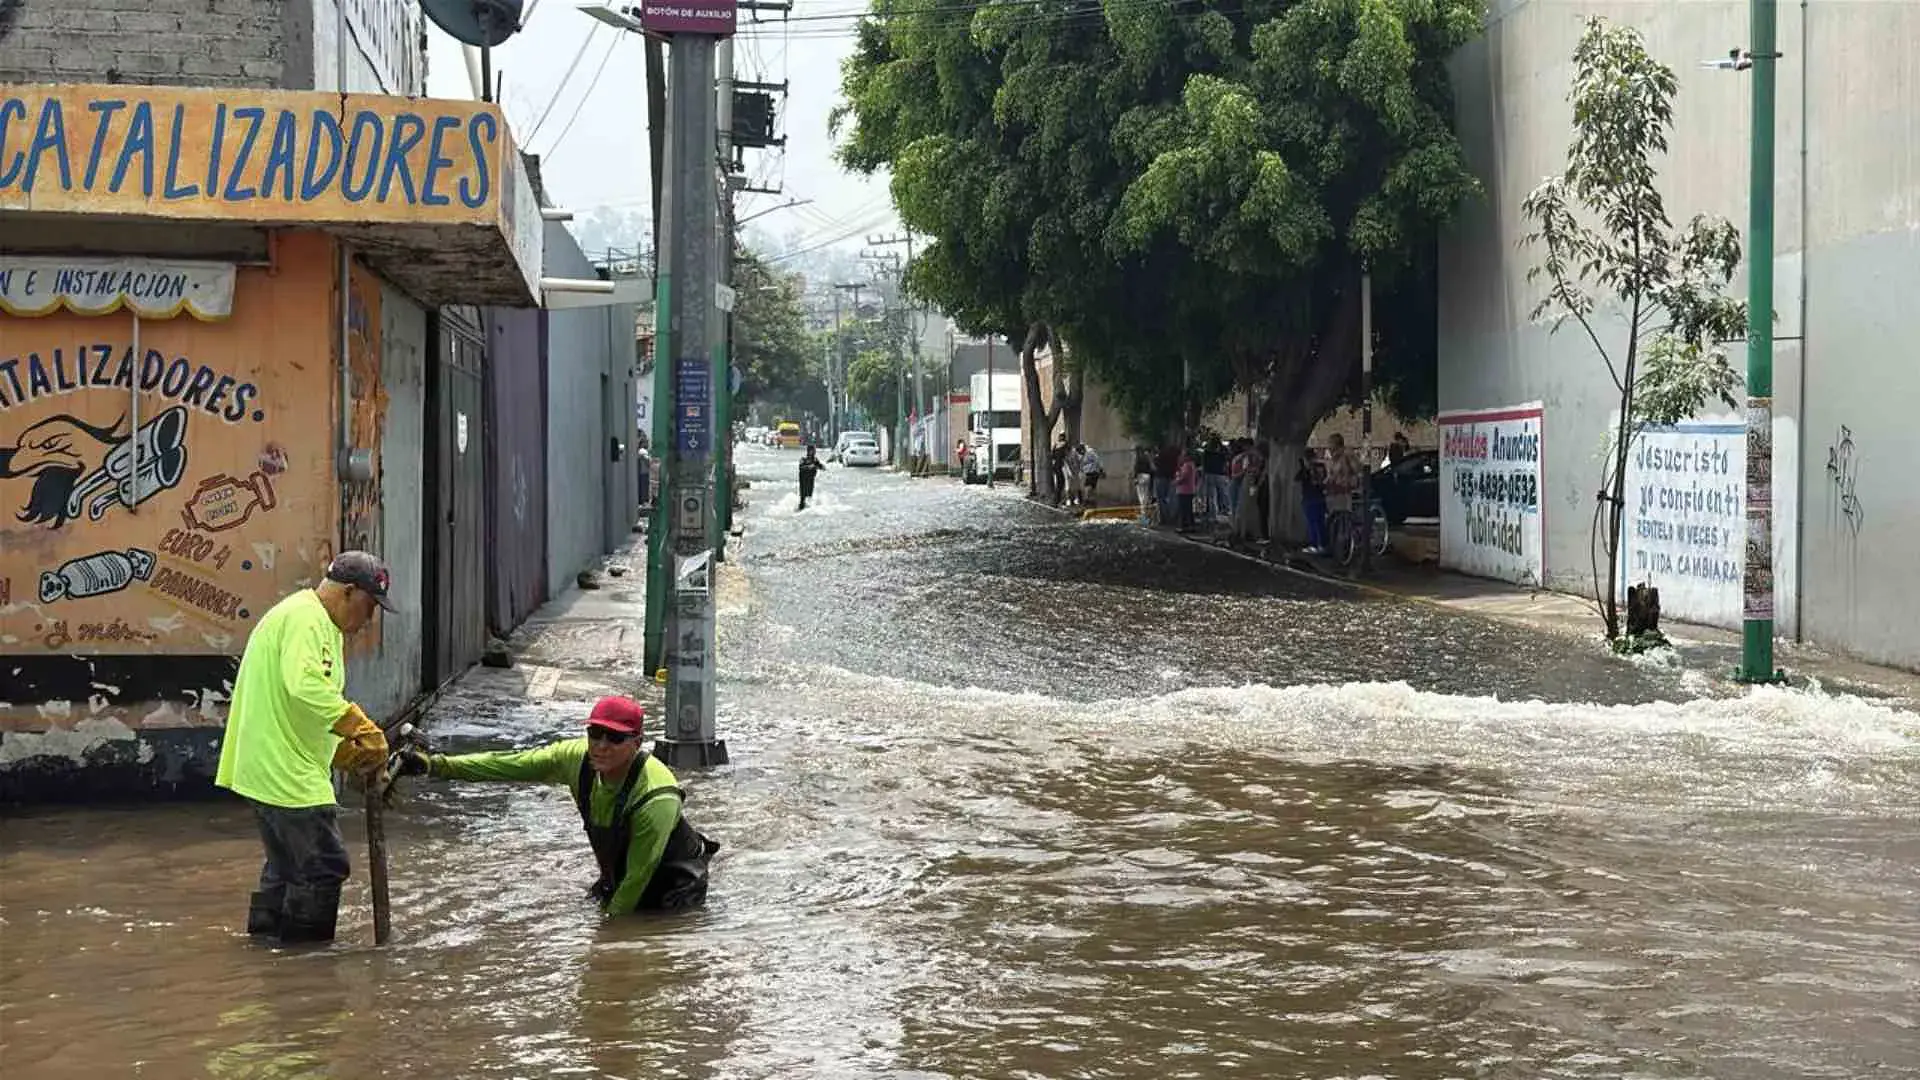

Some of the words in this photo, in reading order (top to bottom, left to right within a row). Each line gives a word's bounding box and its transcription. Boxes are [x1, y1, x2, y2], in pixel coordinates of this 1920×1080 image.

[647, 6, 679, 17] BOTÓN
[680, 8, 693, 17] DE
[695, 9, 732, 19] AUXILIO
[0, 97, 497, 209] CATALIZADORES
[25, 270, 38, 295] E
[52, 270, 188, 298] INSTALACION
[1492, 422, 1539, 463] Anuncios
[1637, 435, 1729, 475] Jesucristo
[1639, 484, 1654, 517] yo
[158, 527, 215, 562] EURO
[1464, 502, 1523, 556] Publicidad
[1651, 551, 1673, 574] VIDA
